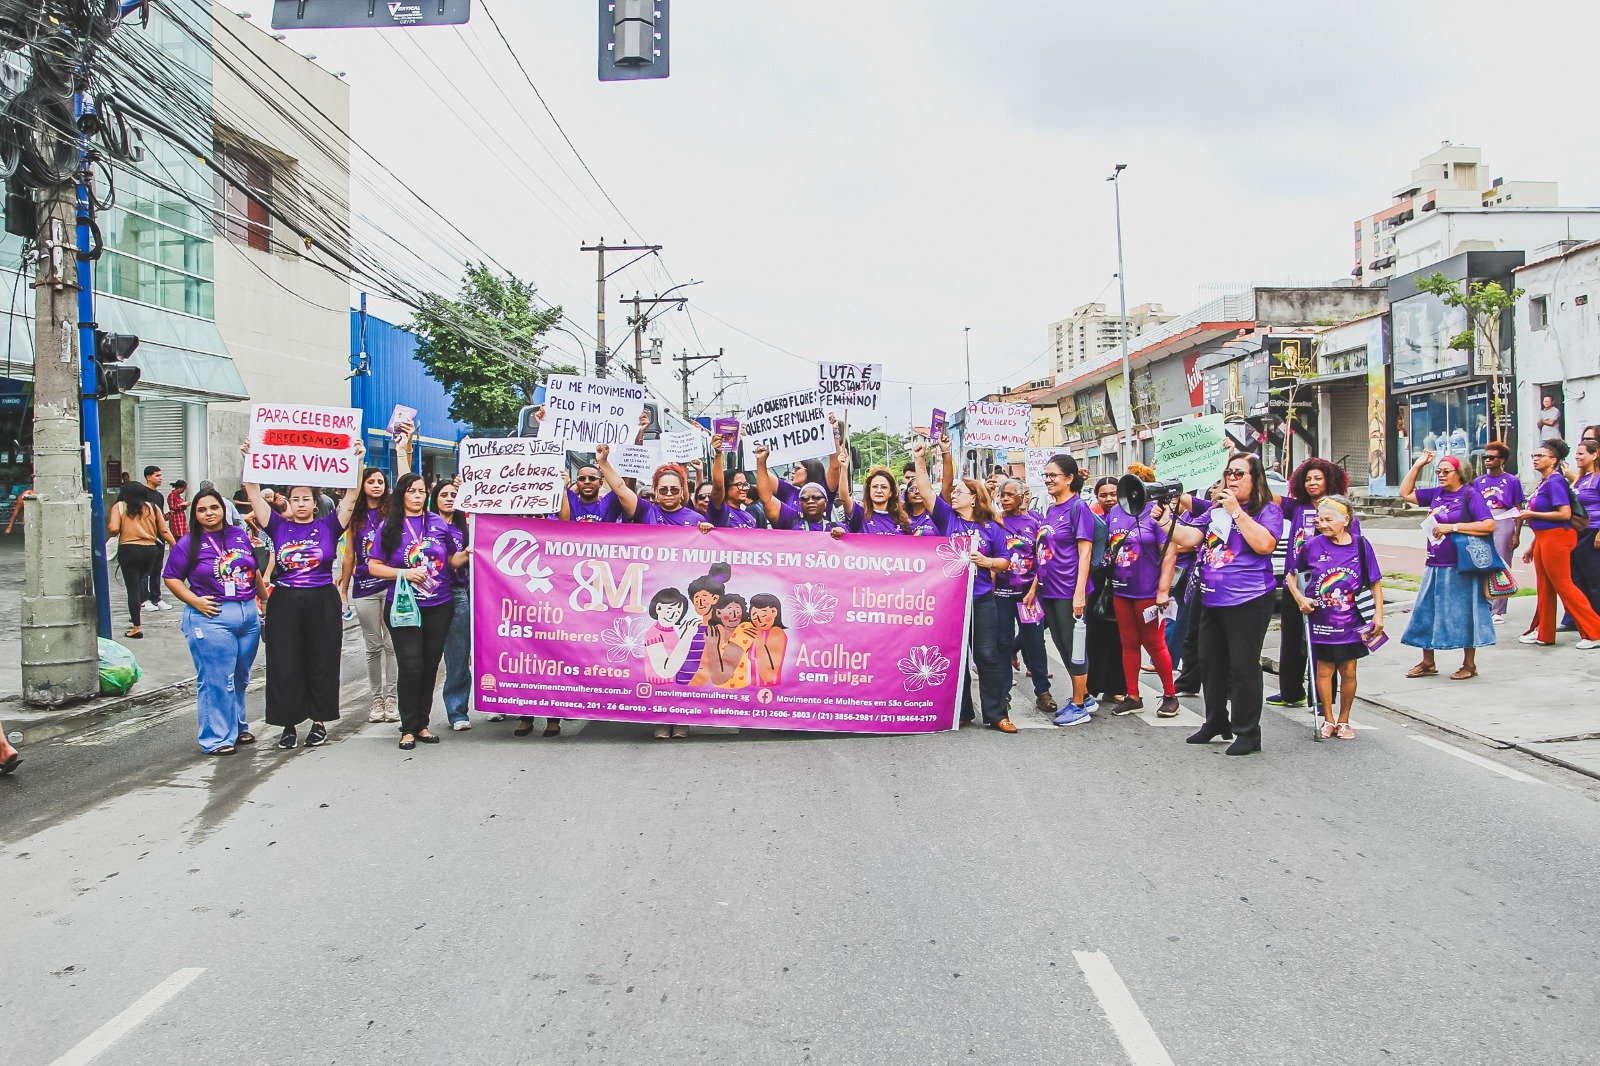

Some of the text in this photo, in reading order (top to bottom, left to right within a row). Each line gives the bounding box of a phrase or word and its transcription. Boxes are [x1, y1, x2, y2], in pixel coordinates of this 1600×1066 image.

[820, 363, 872, 380] LUTA É
[550, 379, 642, 400] EU ME MOVIMENTO
[818, 379, 881, 394] SUBSTANTIVO
[550, 396, 624, 416] PELO FIM DO
[763, 398, 788, 414] QUERO
[819, 393, 877, 410] FEMININO!
[969, 404, 978, 415] A
[1008, 407, 1028, 417] DAS
[256, 407, 356, 431] PARA CELEBRAR,
[745, 407, 825, 437] QUERO SER MULHER
[976, 418, 1017, 426] MULHERES
[269, 432, 340, 447] PRECISAMOS
[783, 424, 825, 448] MEDO!
[966, 432, 991, 441] MUDA
[1001, 434, 1026, 444] MUNDO
[252, 453, 350, 474] ESTAR VIVAS
[544, 540, 927, 576] MOVIMENTO DE MULHERES EM SÃO GONÇALO
[568, 558, 650, 614] 8M
[851, 586, 936, 611] Liberdade
[501, 597, 564, 625] Direito
[497, 620, 599, 643] das mulheres
[498, 651, 565, 677] Cultivar
[583, 665, 631, 679] afetos
[795, 643, 872, 670] Acolher
[498, 681, 633, 696] www.movimentomulheres.com.br
[798, 671, 874, 686] sem julgar
[654, 690, 750, 702] movimentomulheres_sg
[776, 695, 822, 704] Movimento
[835, 697, 873, 706] Mulheres
[888, 699, 902, 707] São
[903, 700, 934, 709] Gonçalo
[482, 695, 497, 703] Rua
[498, 696, 538, 707] Rodrigues
[538, 698, 549, 706] da
[550, 699, 585, 709] Fonseca,
[587, 701, 601, 709] 201
[606, 702, 617, 710] Zé
[618, 703, 646, 712] Garoto
[652, 705, 667, 713] São
[669, 706, 702, 716] Gonçalo
[709, 707, 751, 717] Telefones:
[752, 709, 768, 718] (21)
[817, 712, 833, 721] (21)
[834, 713, 873, 721] 3856-2981
[880, 714, 896, 722] (21)
[896, 714, 937, 722] 98464-2179
